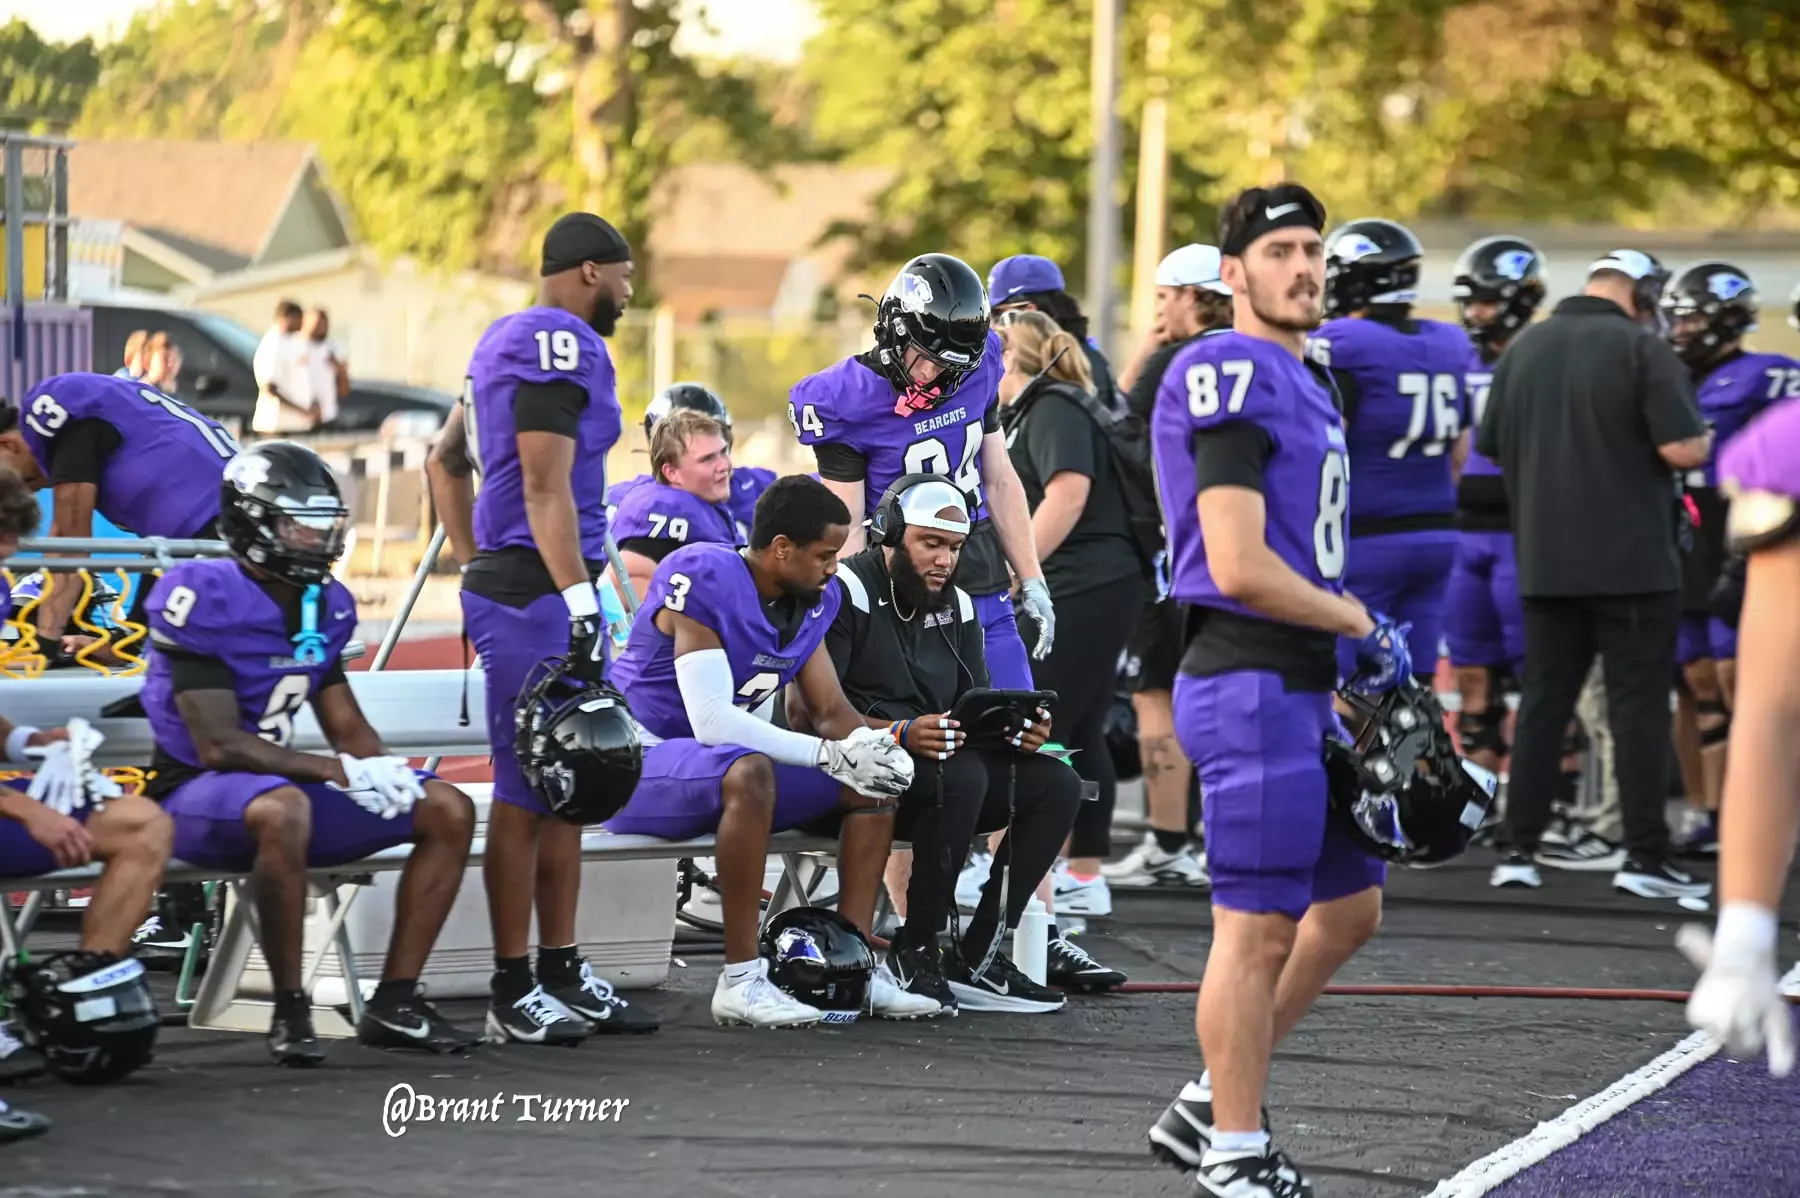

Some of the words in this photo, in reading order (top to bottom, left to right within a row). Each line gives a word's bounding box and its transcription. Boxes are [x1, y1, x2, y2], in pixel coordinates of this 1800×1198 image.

[533, 329, 579, 371] 19
[1185, 359, 1254, 417] 87
[25, 394, 68, 437] 13
[139, 388, 244, 458] 1
[914, 407, 967, 435] BEARCATS
[1388, 373, 1460, 459] 76
[648, 513, 689, 542] 79
[1313, 451, 1350, 579] 8
[161, 585, 197, 628] 9
[664, 572, 692, 612] 3
